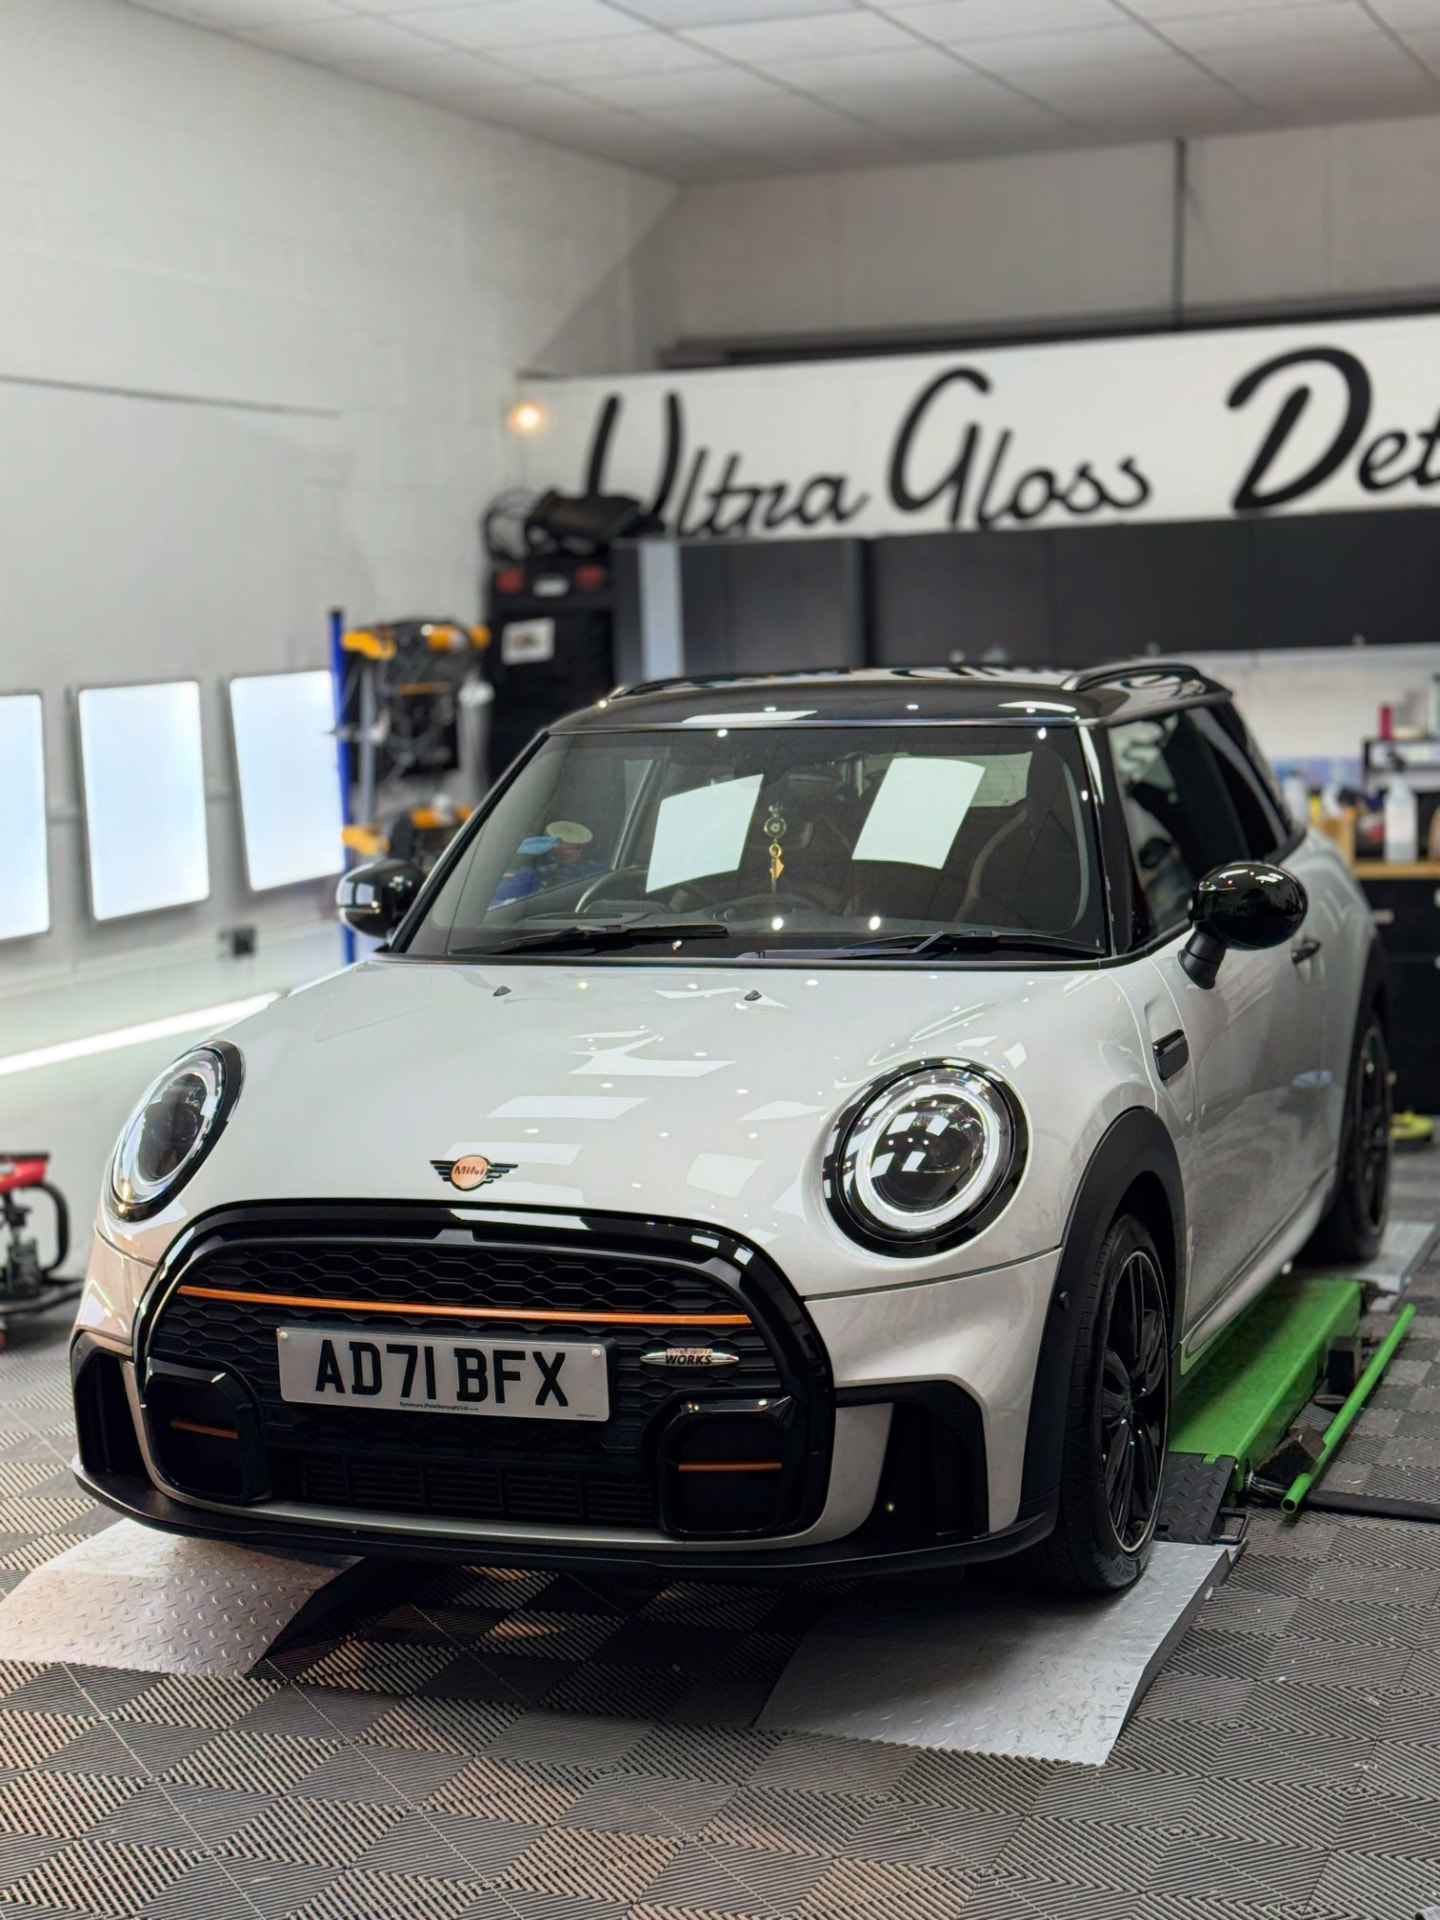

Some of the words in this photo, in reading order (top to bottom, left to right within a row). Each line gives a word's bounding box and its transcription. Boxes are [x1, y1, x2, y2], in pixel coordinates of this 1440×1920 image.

[585, 393, 870, 538] Ultra
[889, 366, 1152, 530] Gloss
[454, 1165, 485, 1175] MINI
[315, 1339, 437, 1400] AD71
[453, 1347, 569, 1407] BFX
[665, 1354, 713, 1365] WORKS
